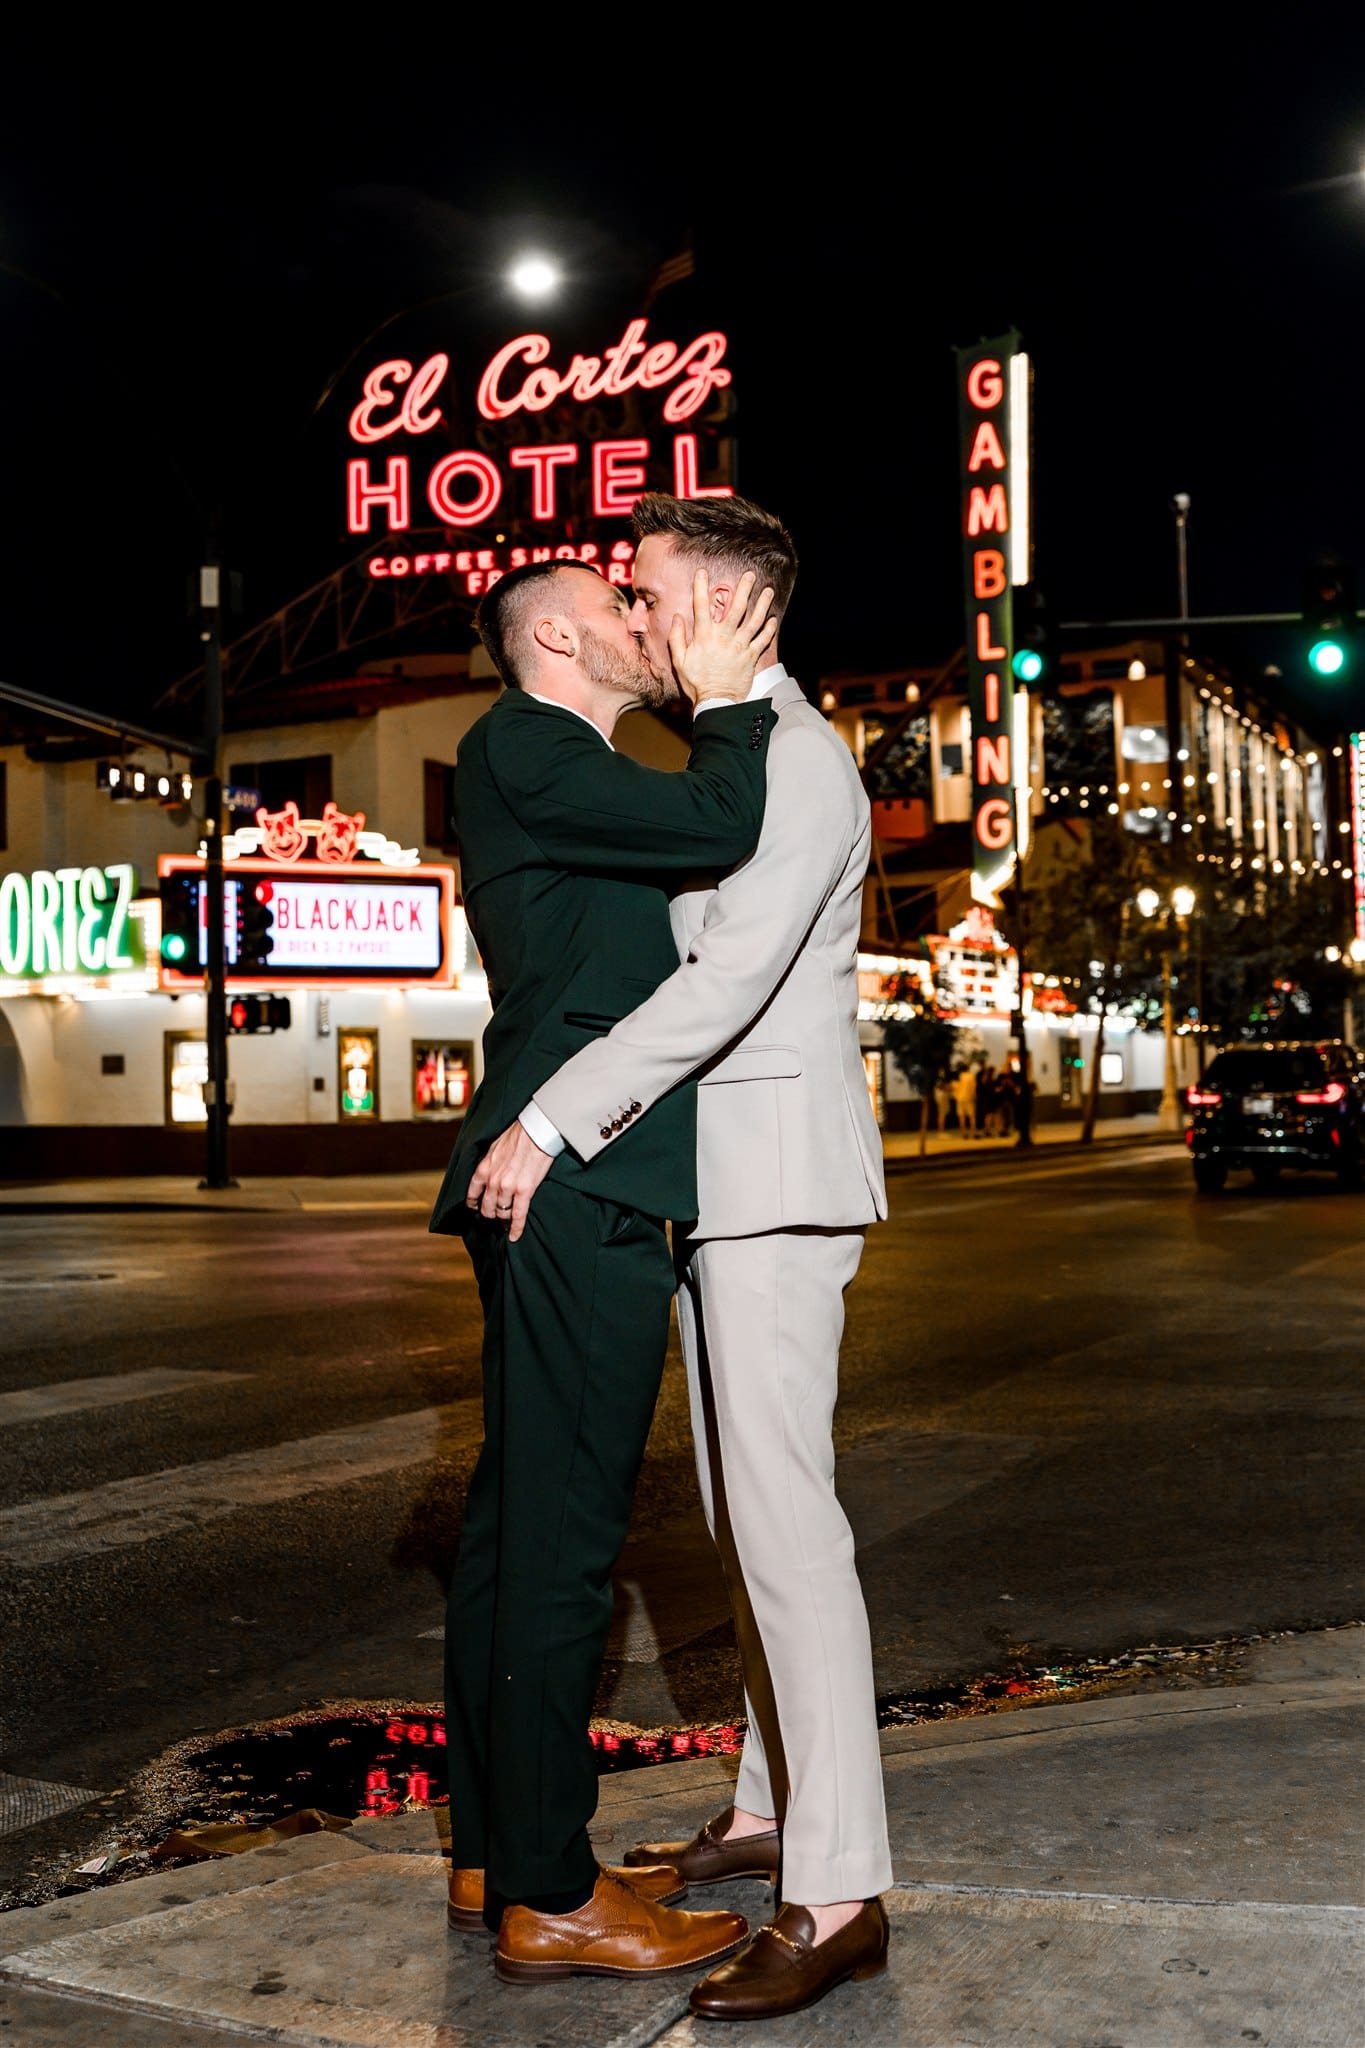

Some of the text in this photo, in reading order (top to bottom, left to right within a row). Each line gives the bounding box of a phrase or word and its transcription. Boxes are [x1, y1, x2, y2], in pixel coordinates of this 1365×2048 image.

[348, 317, 732, 444] El Cortez
[347, 433, 735, 533] HOTEL
[368, 550, 494, 578] COFFEE
[510, 543, 598, 569] SHOP
[966, 358, 1014, 851] GAMBLING
[277, 897, 422, 932] BLACKJACK
